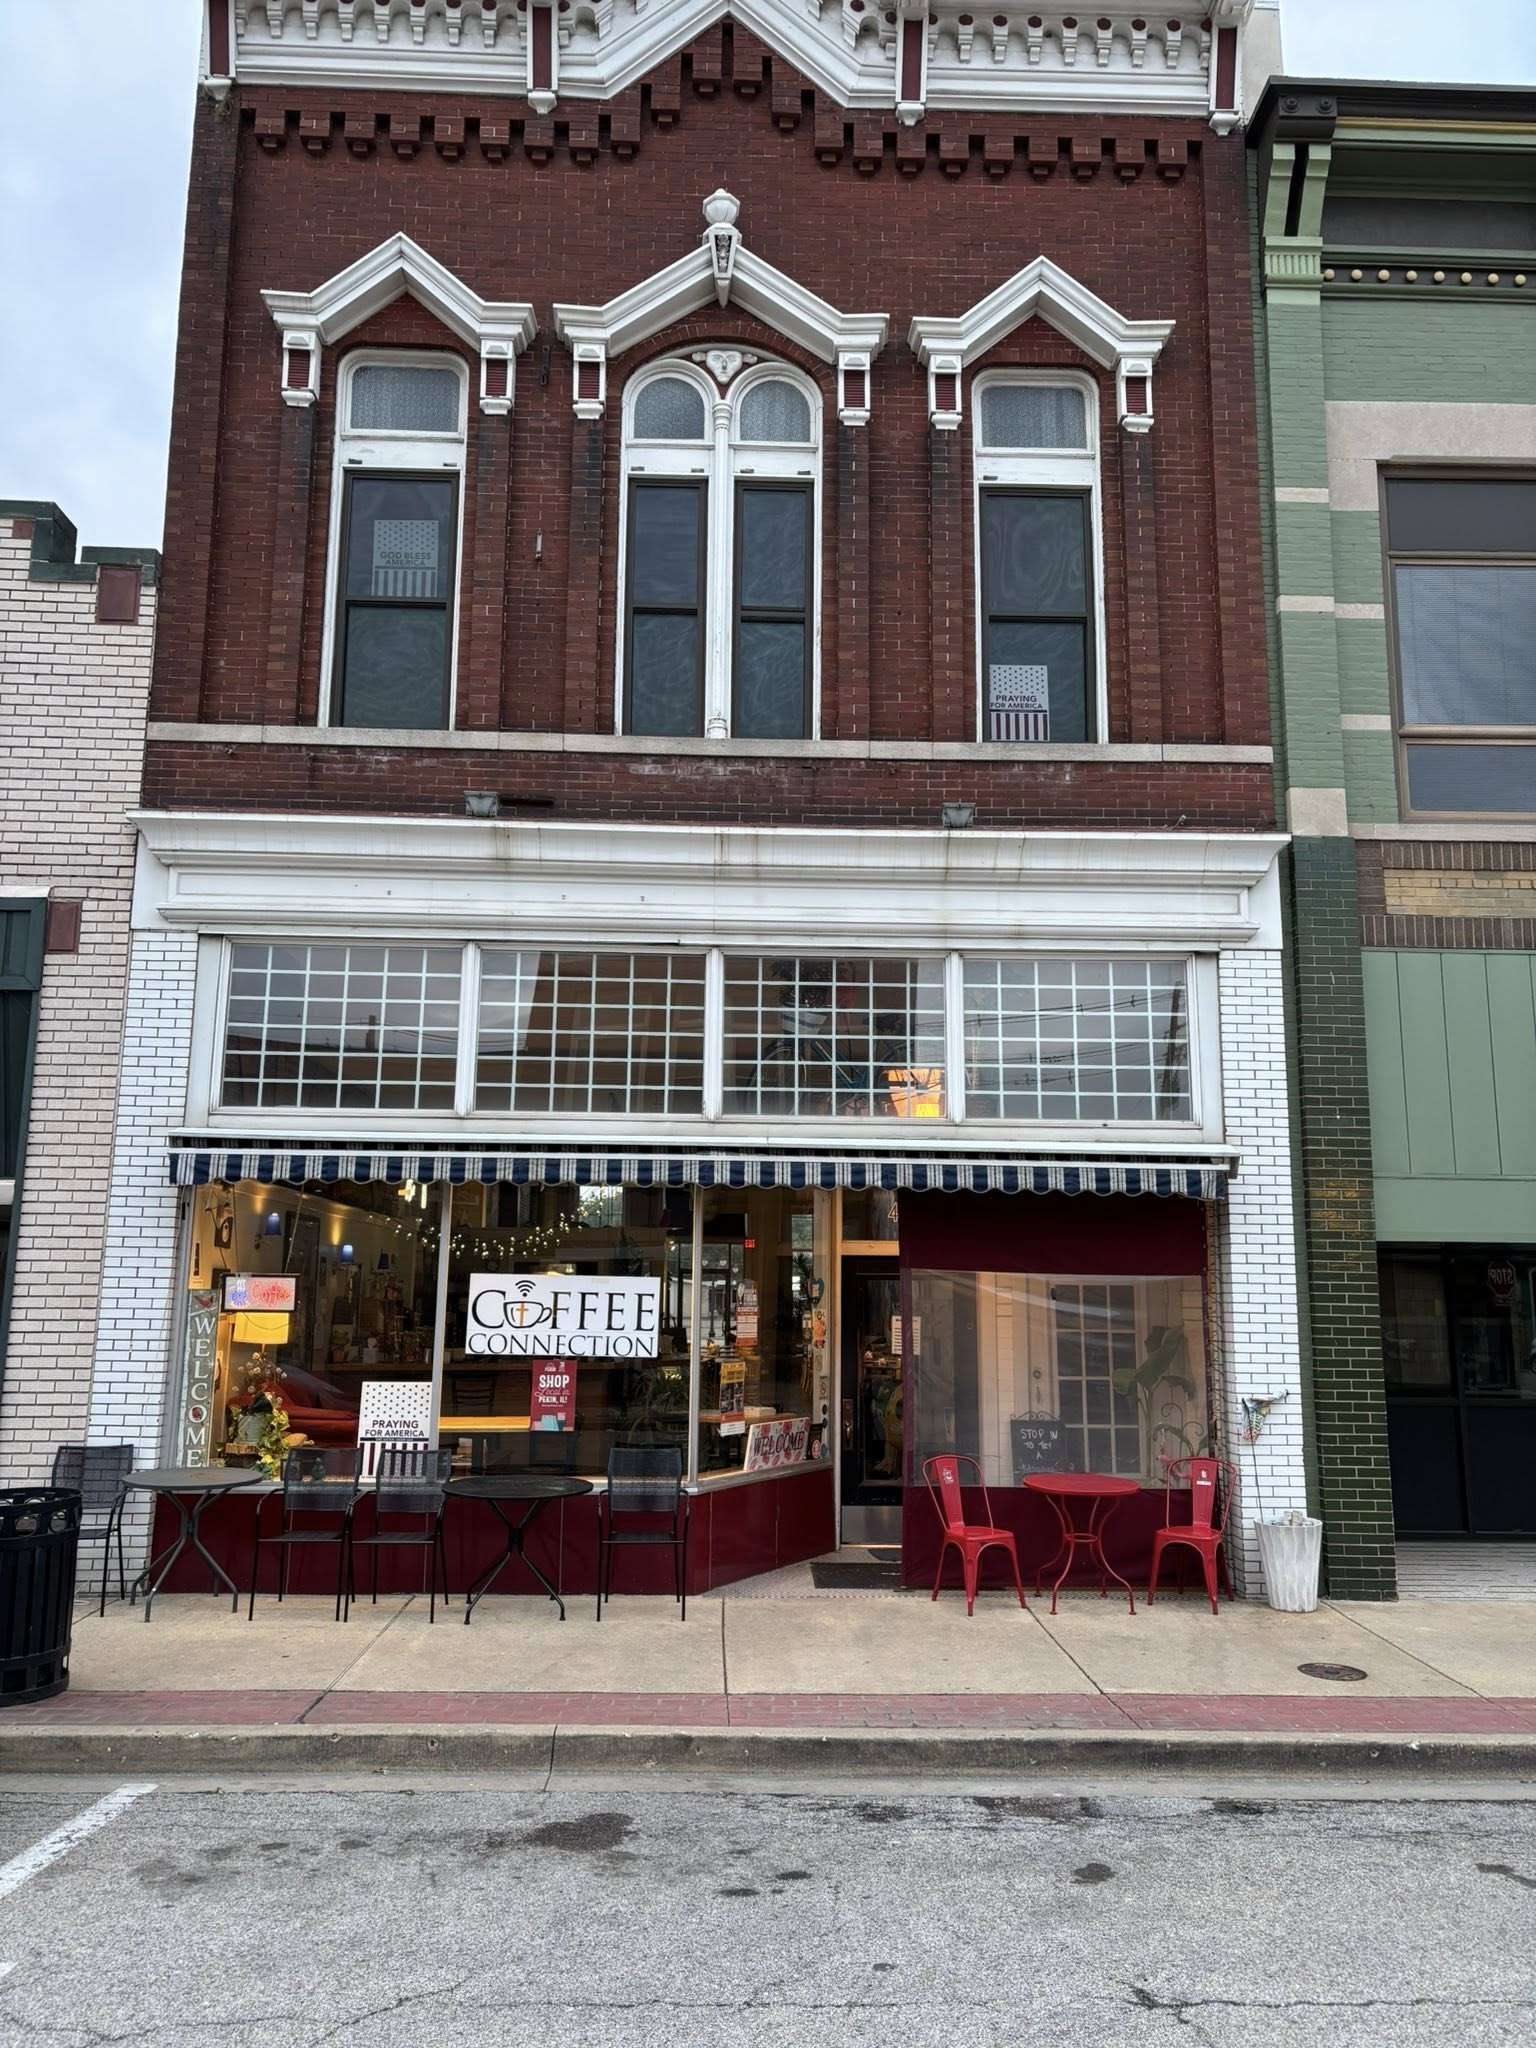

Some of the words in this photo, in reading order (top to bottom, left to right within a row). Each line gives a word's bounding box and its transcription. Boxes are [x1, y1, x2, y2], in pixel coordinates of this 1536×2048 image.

[380, 551, 402, 559] GOD
[385, 559, 426, 567] AMERICA
[996, 695, 1037, 703] PRAYING
[468, 1332, 656, 1357] CONNECTION
[539, 1374, 570, 1388] SHOP
[185, 1316, 217, 1469] WELCOME
[372, 1419, 420, 1429] PRAYING
[364, 1429, 384, 1437] FOR
[384, 1429, 425, 1438] AMERICA
[1020, 1428, 1044, 1439] STOP
[753, 1431, 805, 1457] WELCOME
